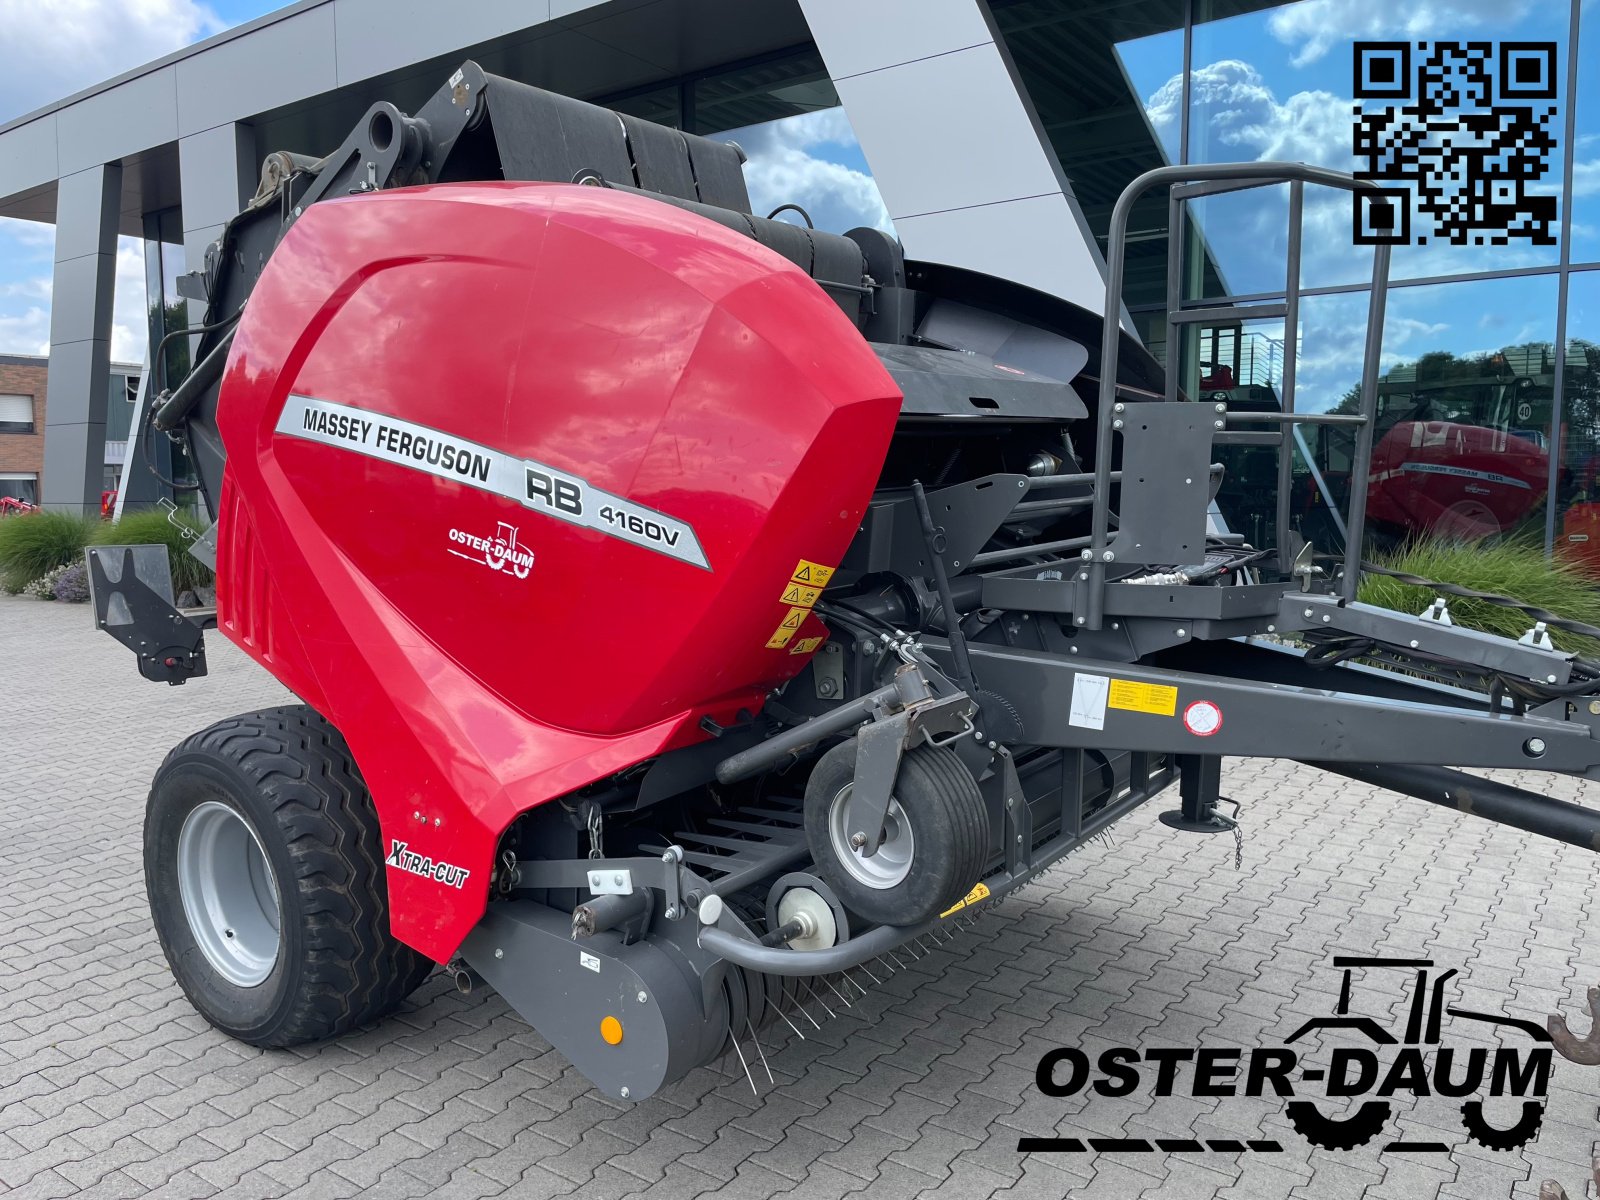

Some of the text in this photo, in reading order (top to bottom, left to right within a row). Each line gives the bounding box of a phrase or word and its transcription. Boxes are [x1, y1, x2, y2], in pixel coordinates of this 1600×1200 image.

[1519, 406, 1530, 418] 40
[303, 408, 680, 547] MASSEY FERGUSON RB 4160V
[448, 528, 535, 569] OSTER-DAUM
[386, 840, 469, 889] XTRA-CUT
